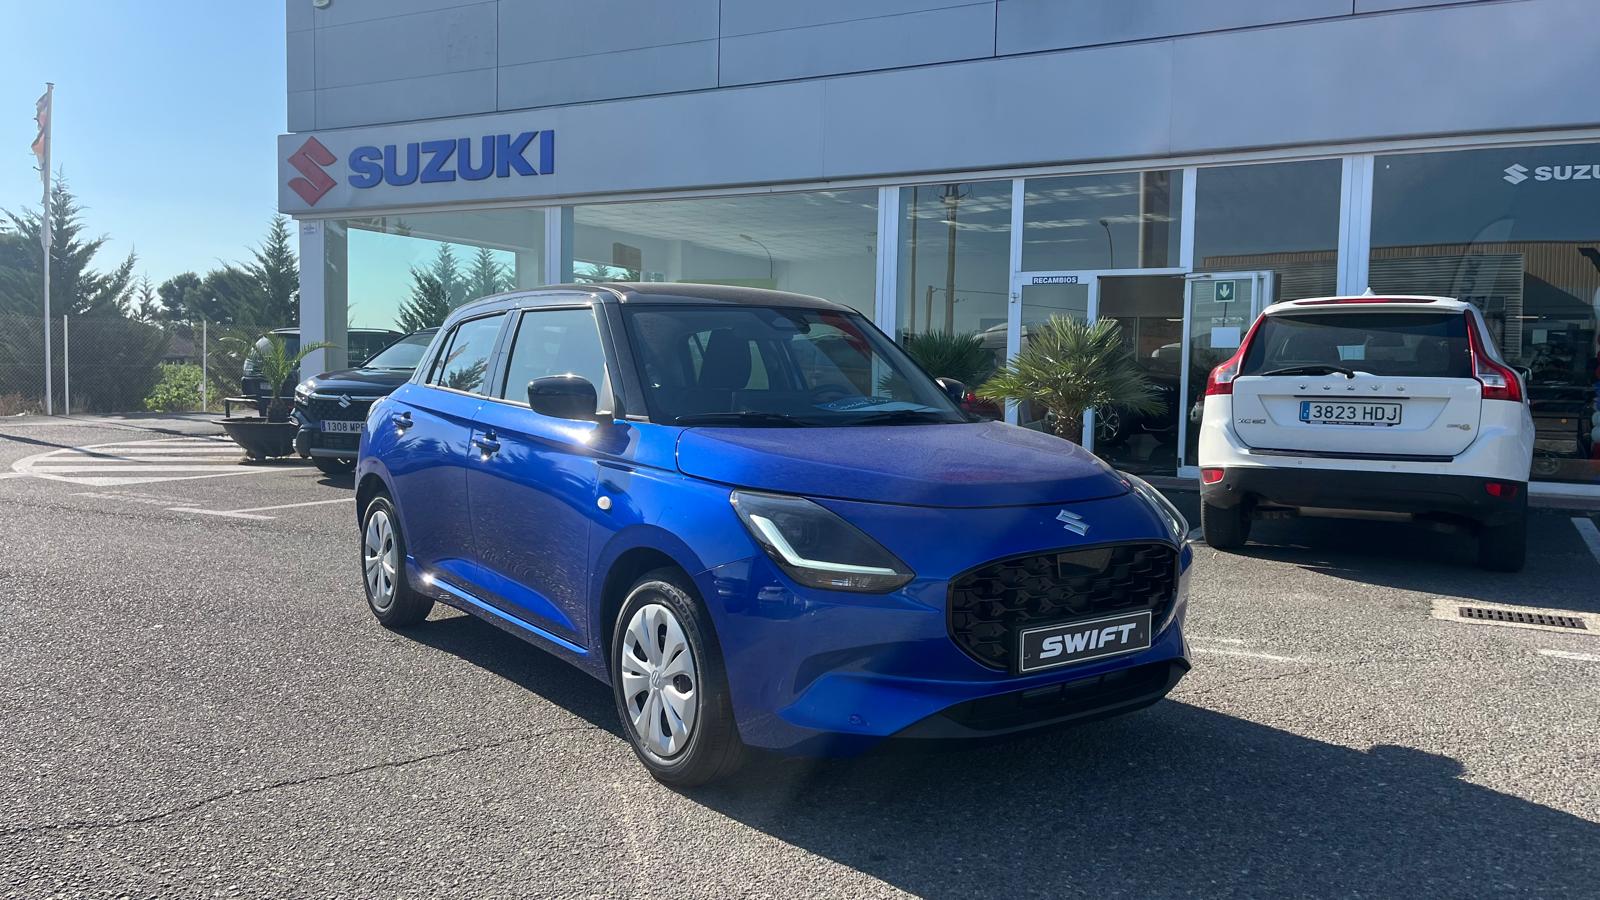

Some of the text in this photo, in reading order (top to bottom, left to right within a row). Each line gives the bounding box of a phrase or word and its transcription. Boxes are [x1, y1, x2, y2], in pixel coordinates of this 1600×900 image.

[348, 129, 555, 189] SUZUKI
[1033, 276, 1077, 284] RECAMBIOS
[1313, 404, 1397, 421] 3823 HDJ
[327, 422, 348, 432] 1308
[1040, 622, 1137, 659] SWIFT
